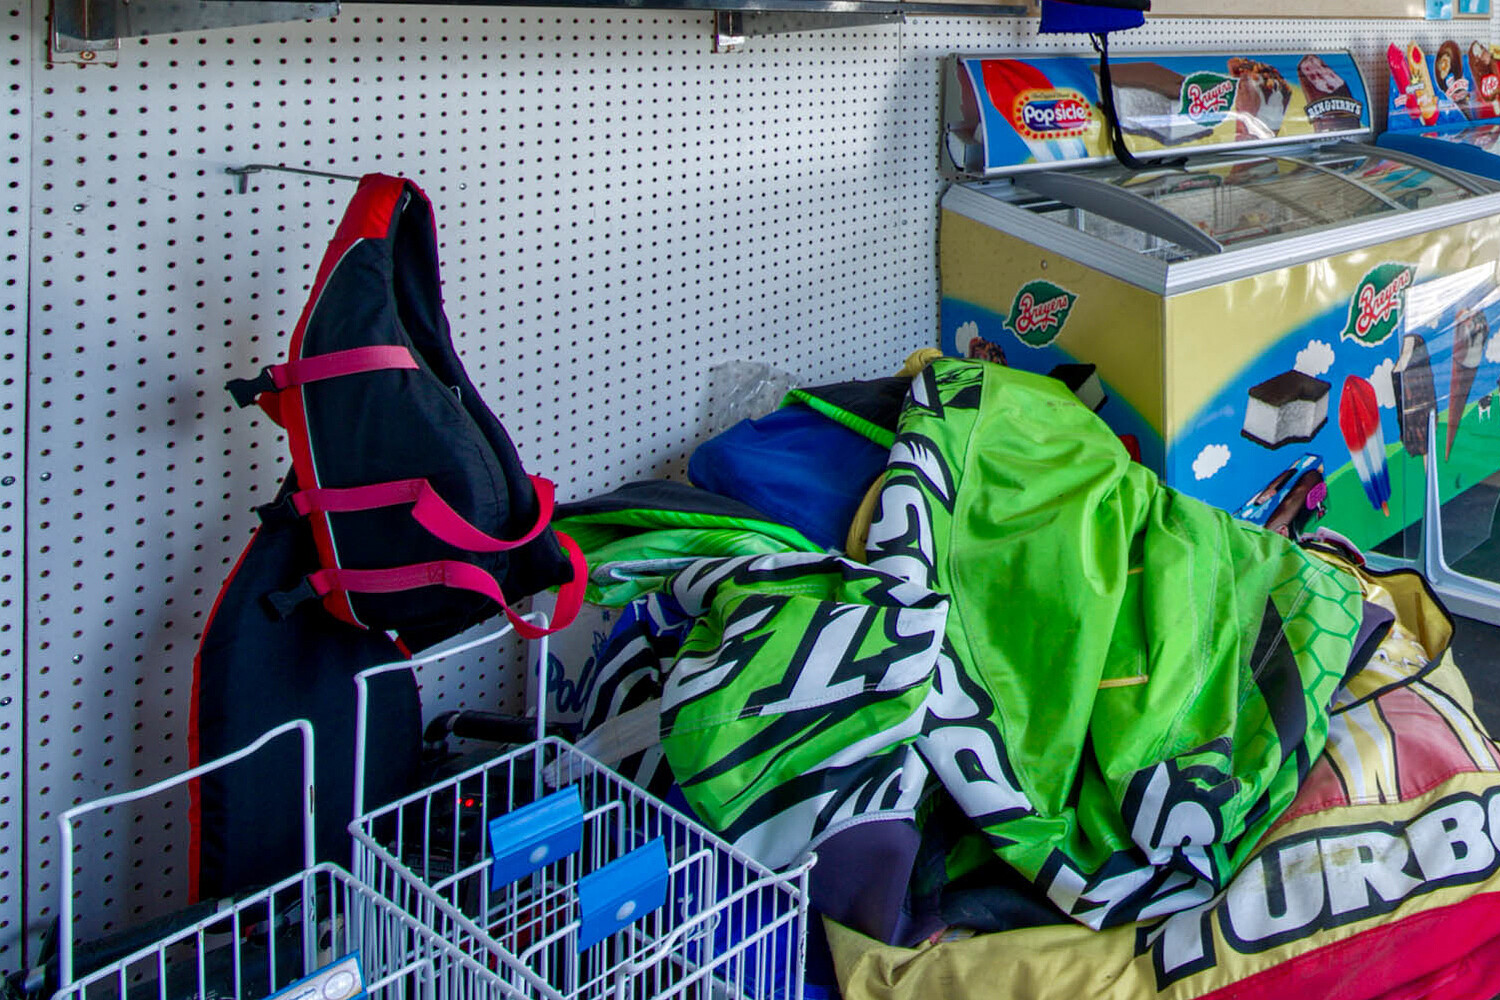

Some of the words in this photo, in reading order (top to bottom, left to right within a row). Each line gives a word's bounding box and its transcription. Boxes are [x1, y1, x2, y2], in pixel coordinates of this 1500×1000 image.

[1024, 104, 1087, 126] Popsicle
[1015, 292, 1069, 334] Breyers
[1356, 268, 1411, 336] Breyers
